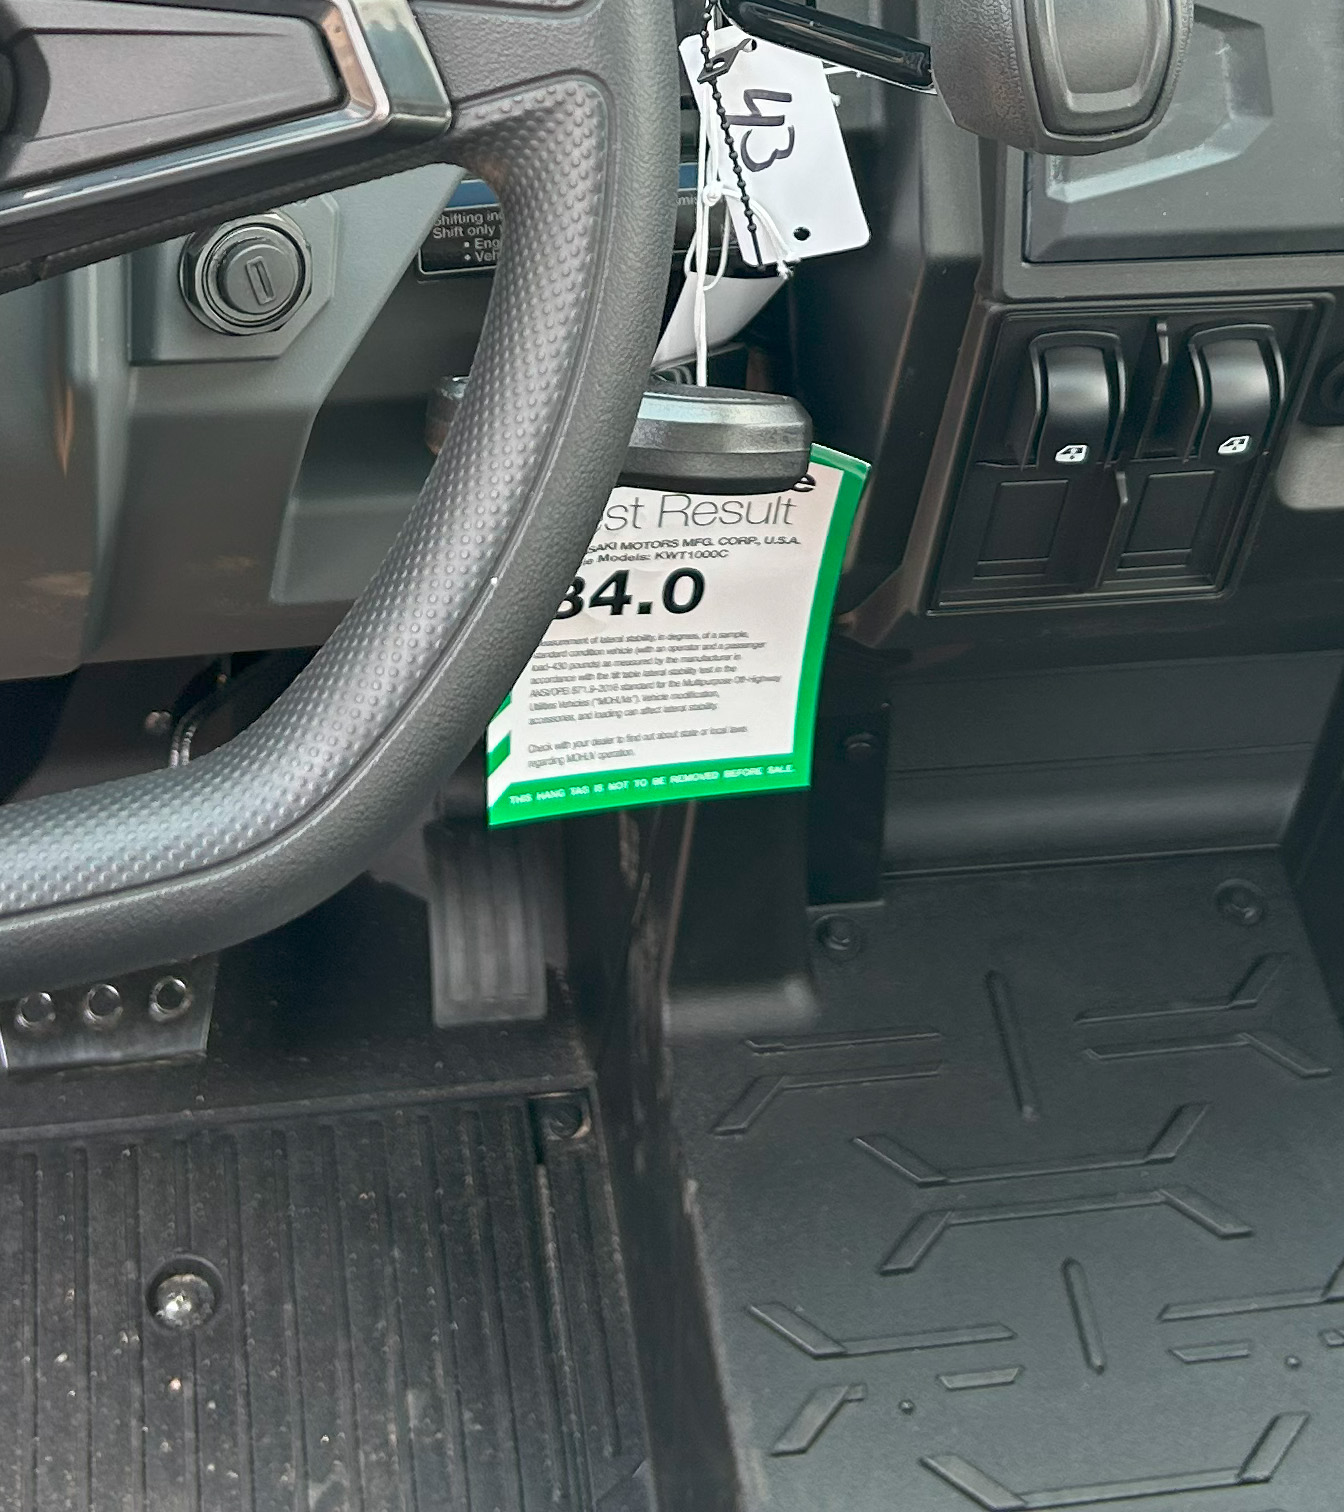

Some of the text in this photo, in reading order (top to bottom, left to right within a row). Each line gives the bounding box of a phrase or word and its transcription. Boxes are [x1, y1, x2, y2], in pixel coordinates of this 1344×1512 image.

[725, 88, 795, 173] 43
[432, 223, 496, 239] Shift only
[596, 493, 797, 531] st Result
[587, 541, 618, 554] SAKI
[619, 538, 679, 551] MOTORS
[682, 537, 715, 548] MFG.
[764, 535, 801, 545] U.S.A.
[597, 552, 652, 564] Models:
[654, 549, 730, 560] KWT1000C
[554, 566, 706, 620] 34.0
[509, 792, 533, 805] THIS
[536, 788, 566, 800] HANG
[568, 785, 591, 796] TAG
[593, 783, 604, 793] IS
[607, 780, 630, 791] NOT
[632, 778, 649, 788] TO
[651, 775, 667, 786] BE
[669, 770, 720, 784] REMOVED
[722, 766, 765, 779] BEFORE
